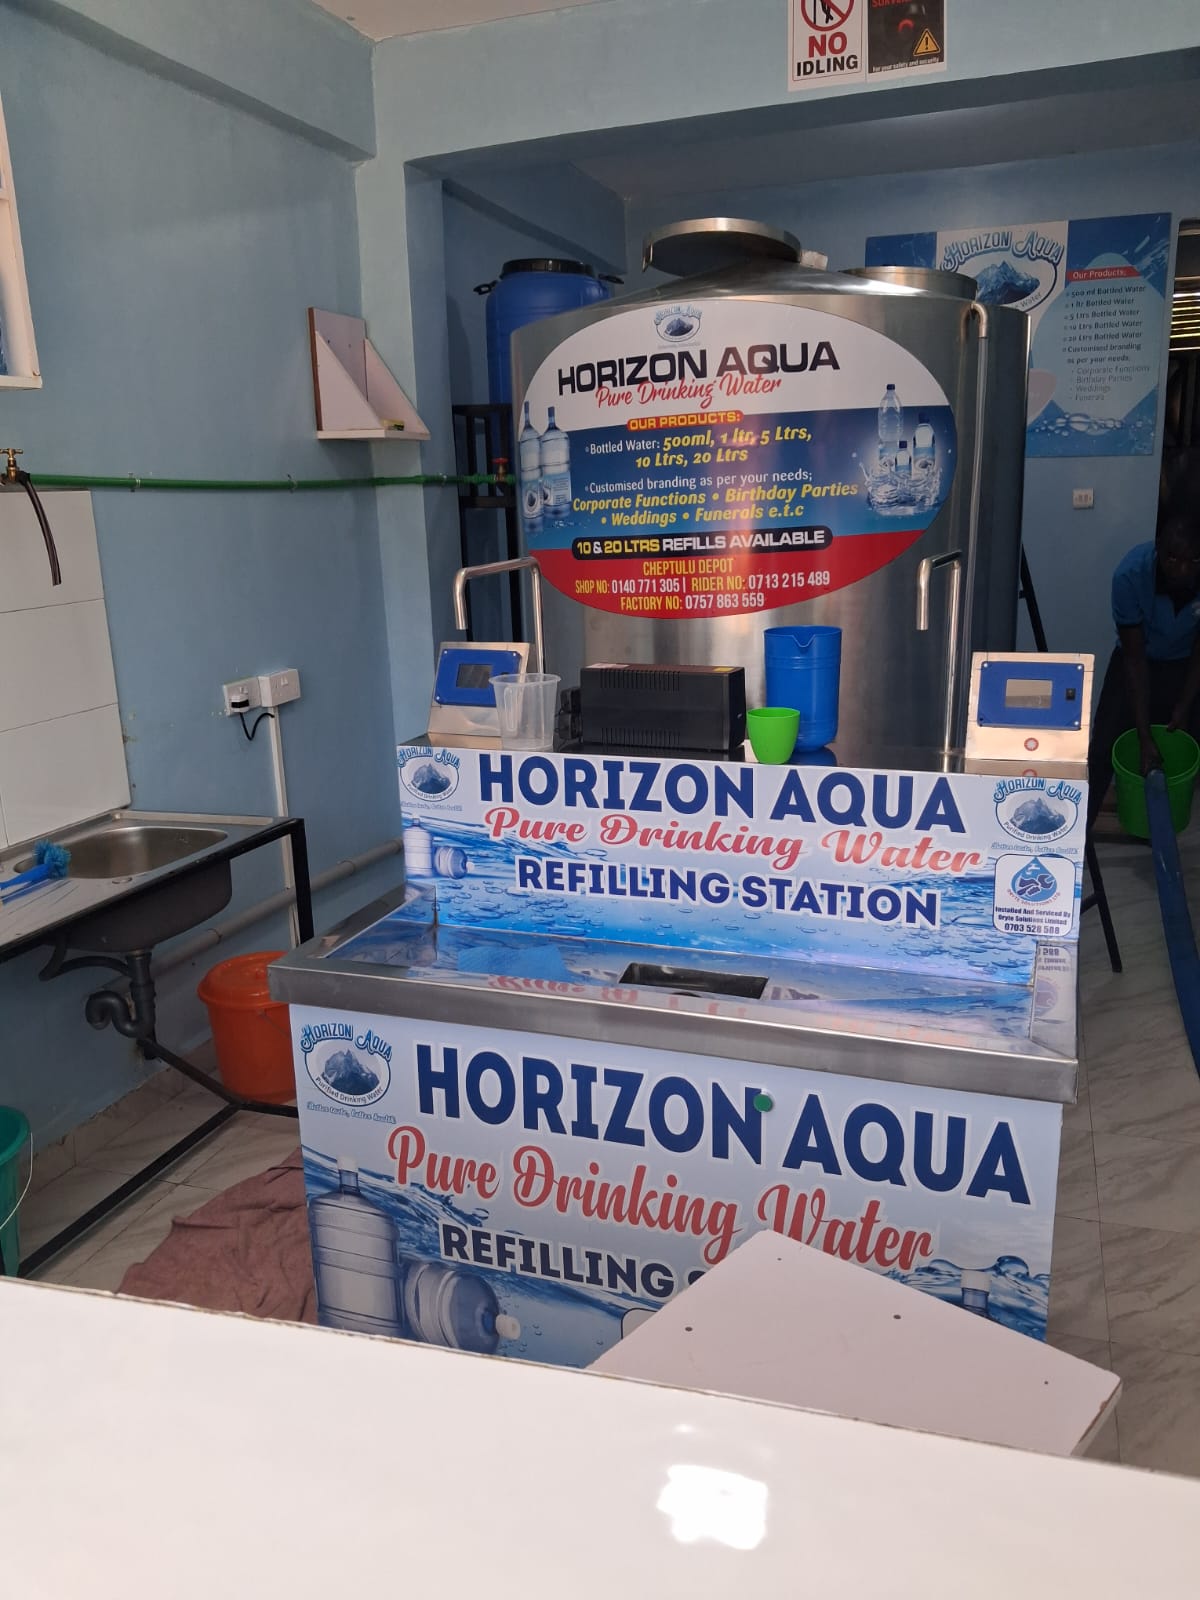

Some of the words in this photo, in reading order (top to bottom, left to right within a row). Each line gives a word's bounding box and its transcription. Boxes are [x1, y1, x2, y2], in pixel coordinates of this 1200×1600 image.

[808, 31, 847, 58] NO
[796, 54, 859, 76] IDLING
[940, 231, 1012, 272] HORIZON
[1012, 230, 1064, 267] AQUA
[1072, 271, 1088, 279] Our
[1086, 298, 1112, 307] Bottled
[1113, 297, 1134, 305] Water
[1097, 286, 1123, 295] Bottled
[1125, 285, 1146, 293] Water
[1091, 310, 1117, 318] Bottled
[1094, 321, 1119, 329] Bottled
[1094, 332, 1119, 340] Bottled
[1121, 331, 1142, 339] Water
[558, 349, 707, 396] HORIZON
[716, 340, 840, 377] AQUA
[595, 385, 633, 409] Pure
[637, 376, 715, 409] Drinking
[719, 372, 782, 397] Water
[629, 417, 657, 430] OUR
[660, 411, 741, 428] PRODUCTS:
[590, 441, 624, 454] Bottled
[626, 438, 660, 452] Water:
[663, 430, 715, 451] 500ml,
[720, 433, 728, 445] 1
[760, 433, 770, 446] 5
[775, 426, 813, 443] Ltrs,
[636, 456, 650, 468] 10
[655, 452, 688, 468] Ltrs,
[693, 452, 711, 464] 20
[716, 448, 749, 462] Ltrs
[589, 480, 644, 494] Customised
[646, 477, 696, 492] branding
[700, 477, 712, 486] as
[717, 475, 736, 488] per
[740, 473, 768, 486] your
[772, 468, 813, 481] needs;
[572, 496, 632, 515] Corporate
[635, 491, 706, 508] Functions
[724, 485, 797, 503] Birthday
[801, 481, 858, 497] Parties
[611, 510, 677, 527] Weddings
[695, 504, 764, 521] Funerals
[768, 503, 804, 518] e.t.c
[577, 541, 592, 554] 10
[593, 541, 603, 553] &
[604, 540, 622, 553] 20
[624, 538, 660, 552] LTRS
[662, 535, 727, 550] REFILLS
[729, 530, 825, 548] AVAILABLE
[643, 559, 696, 575] CHEPTULU
[699, 558, 734, 574] DEPOT
[575, 580, 594, 594] SHOP
[596, 579, 610, 593] NO:
[612, 579, 636, 593] 0140
[638, 579, 658, 593] 771
[660, 578, 679, 593] 305
[691, 577, 729, 592] RIDER
[731, 575, 746, 591] NO:
[748, 572, 779, 589] 0713
[781, 571, 805, 587] 215
[807, 570, 830, 586] 489
[620, 596, 662, 611] FACTORY
[665, 595, 683, 609] NO:
[685, 594, 714, 608] 0757
[717, 593, 739, 608] 863
[742, 591, 765, 607] 559
[397, 746, 434, 768] HORIZON
[434, 748, 461, 769] AQUA
[479, 753, 753, 819] HORIZON
[770, 769, 966, 833] AQUA
[993, 777, 1046, 803] HORIZON
[1046, 780, 1082, 804] AQUA
[485, 806, 588, 842] Pure
[600, 813, 804, 870] Drinking
[821, 829, 981, 872] Water
[518, 858, 730, 904] REFILLING
[742, 875, 937, 926] STATION
[995, 906, 1022, 915] Installed
[1035, 909, 1062, 917] Serviced
[1015, 915, 1043, 923] Solutions
[1045, 917, 1067, 926] Limited
[1005, 922, 1024, 932] 0703
[1026, 924, 1042, 933] 528
[300, 1022, 354, 1053] HORIZON
[355, 1029, 393, 1062] AQUA
[314, 1075, 340, 1101] Purified
[339, 1092, 366, 1104] Drinking
[366, 1086, 384, 1101] Water
[416, 1044, 762, 1165] HORIZON
[782, 1093, 1031, 1205] AQUA
[388, 1125, 500, 1199] Pure
[513, 1145, 742, 1265] Drinking
[757, 1184, 934, 1271] Water
[441, 1222, 675, 1298] REFILLING
